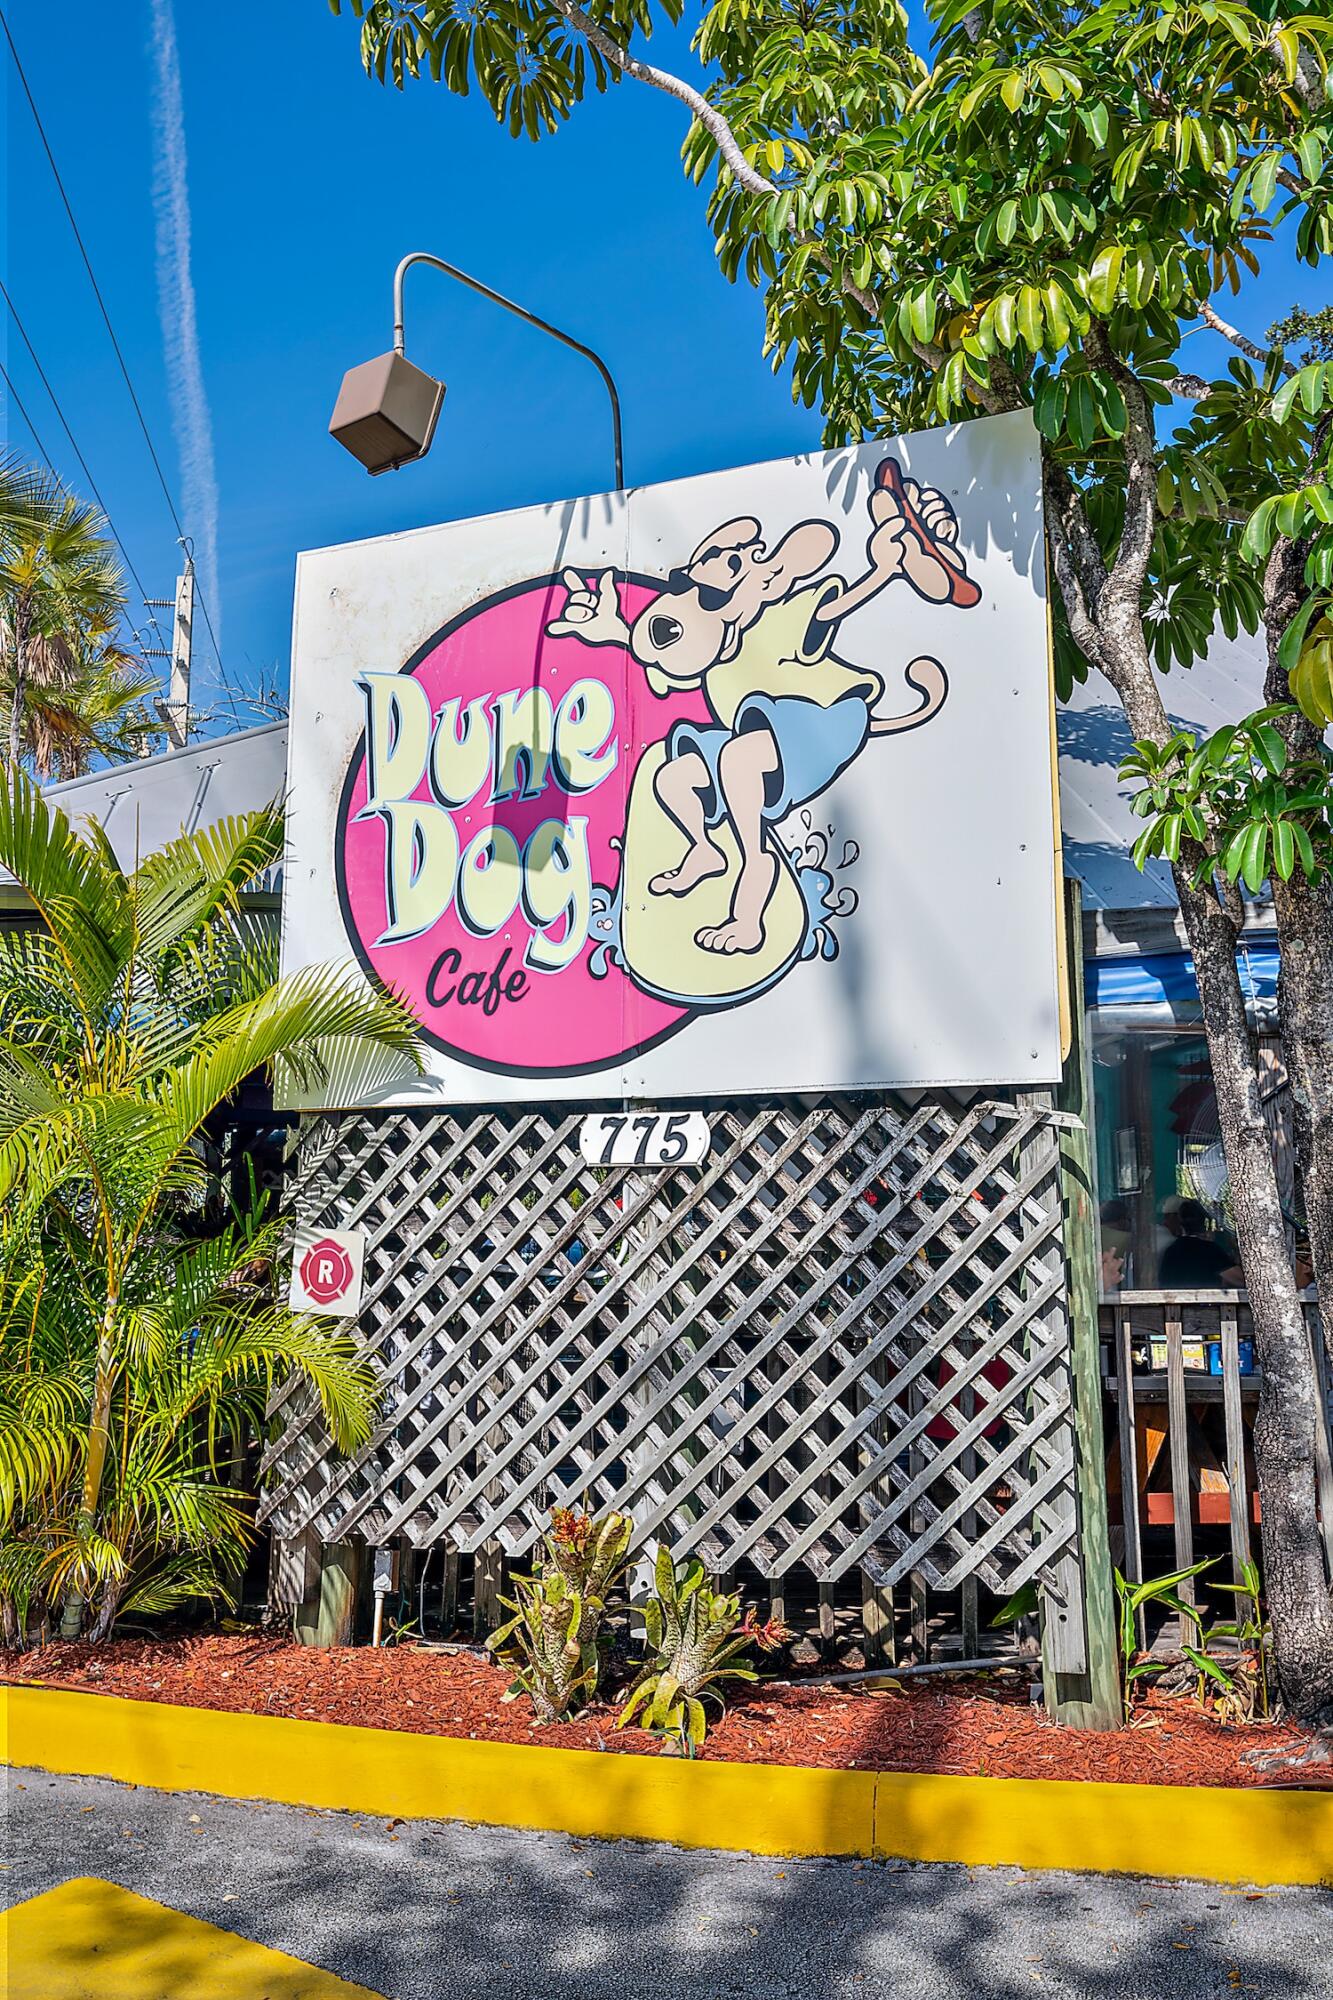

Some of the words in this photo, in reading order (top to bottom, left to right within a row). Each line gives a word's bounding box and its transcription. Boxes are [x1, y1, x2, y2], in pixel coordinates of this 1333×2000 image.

[349, 671, 618, 823] Dune
[368, 801, 592, 974] Dog
[425, 947, 531, 1016] Cafe
[600, 1113, 691, 1164] 775
[317, 1258, 335, 1285] R
